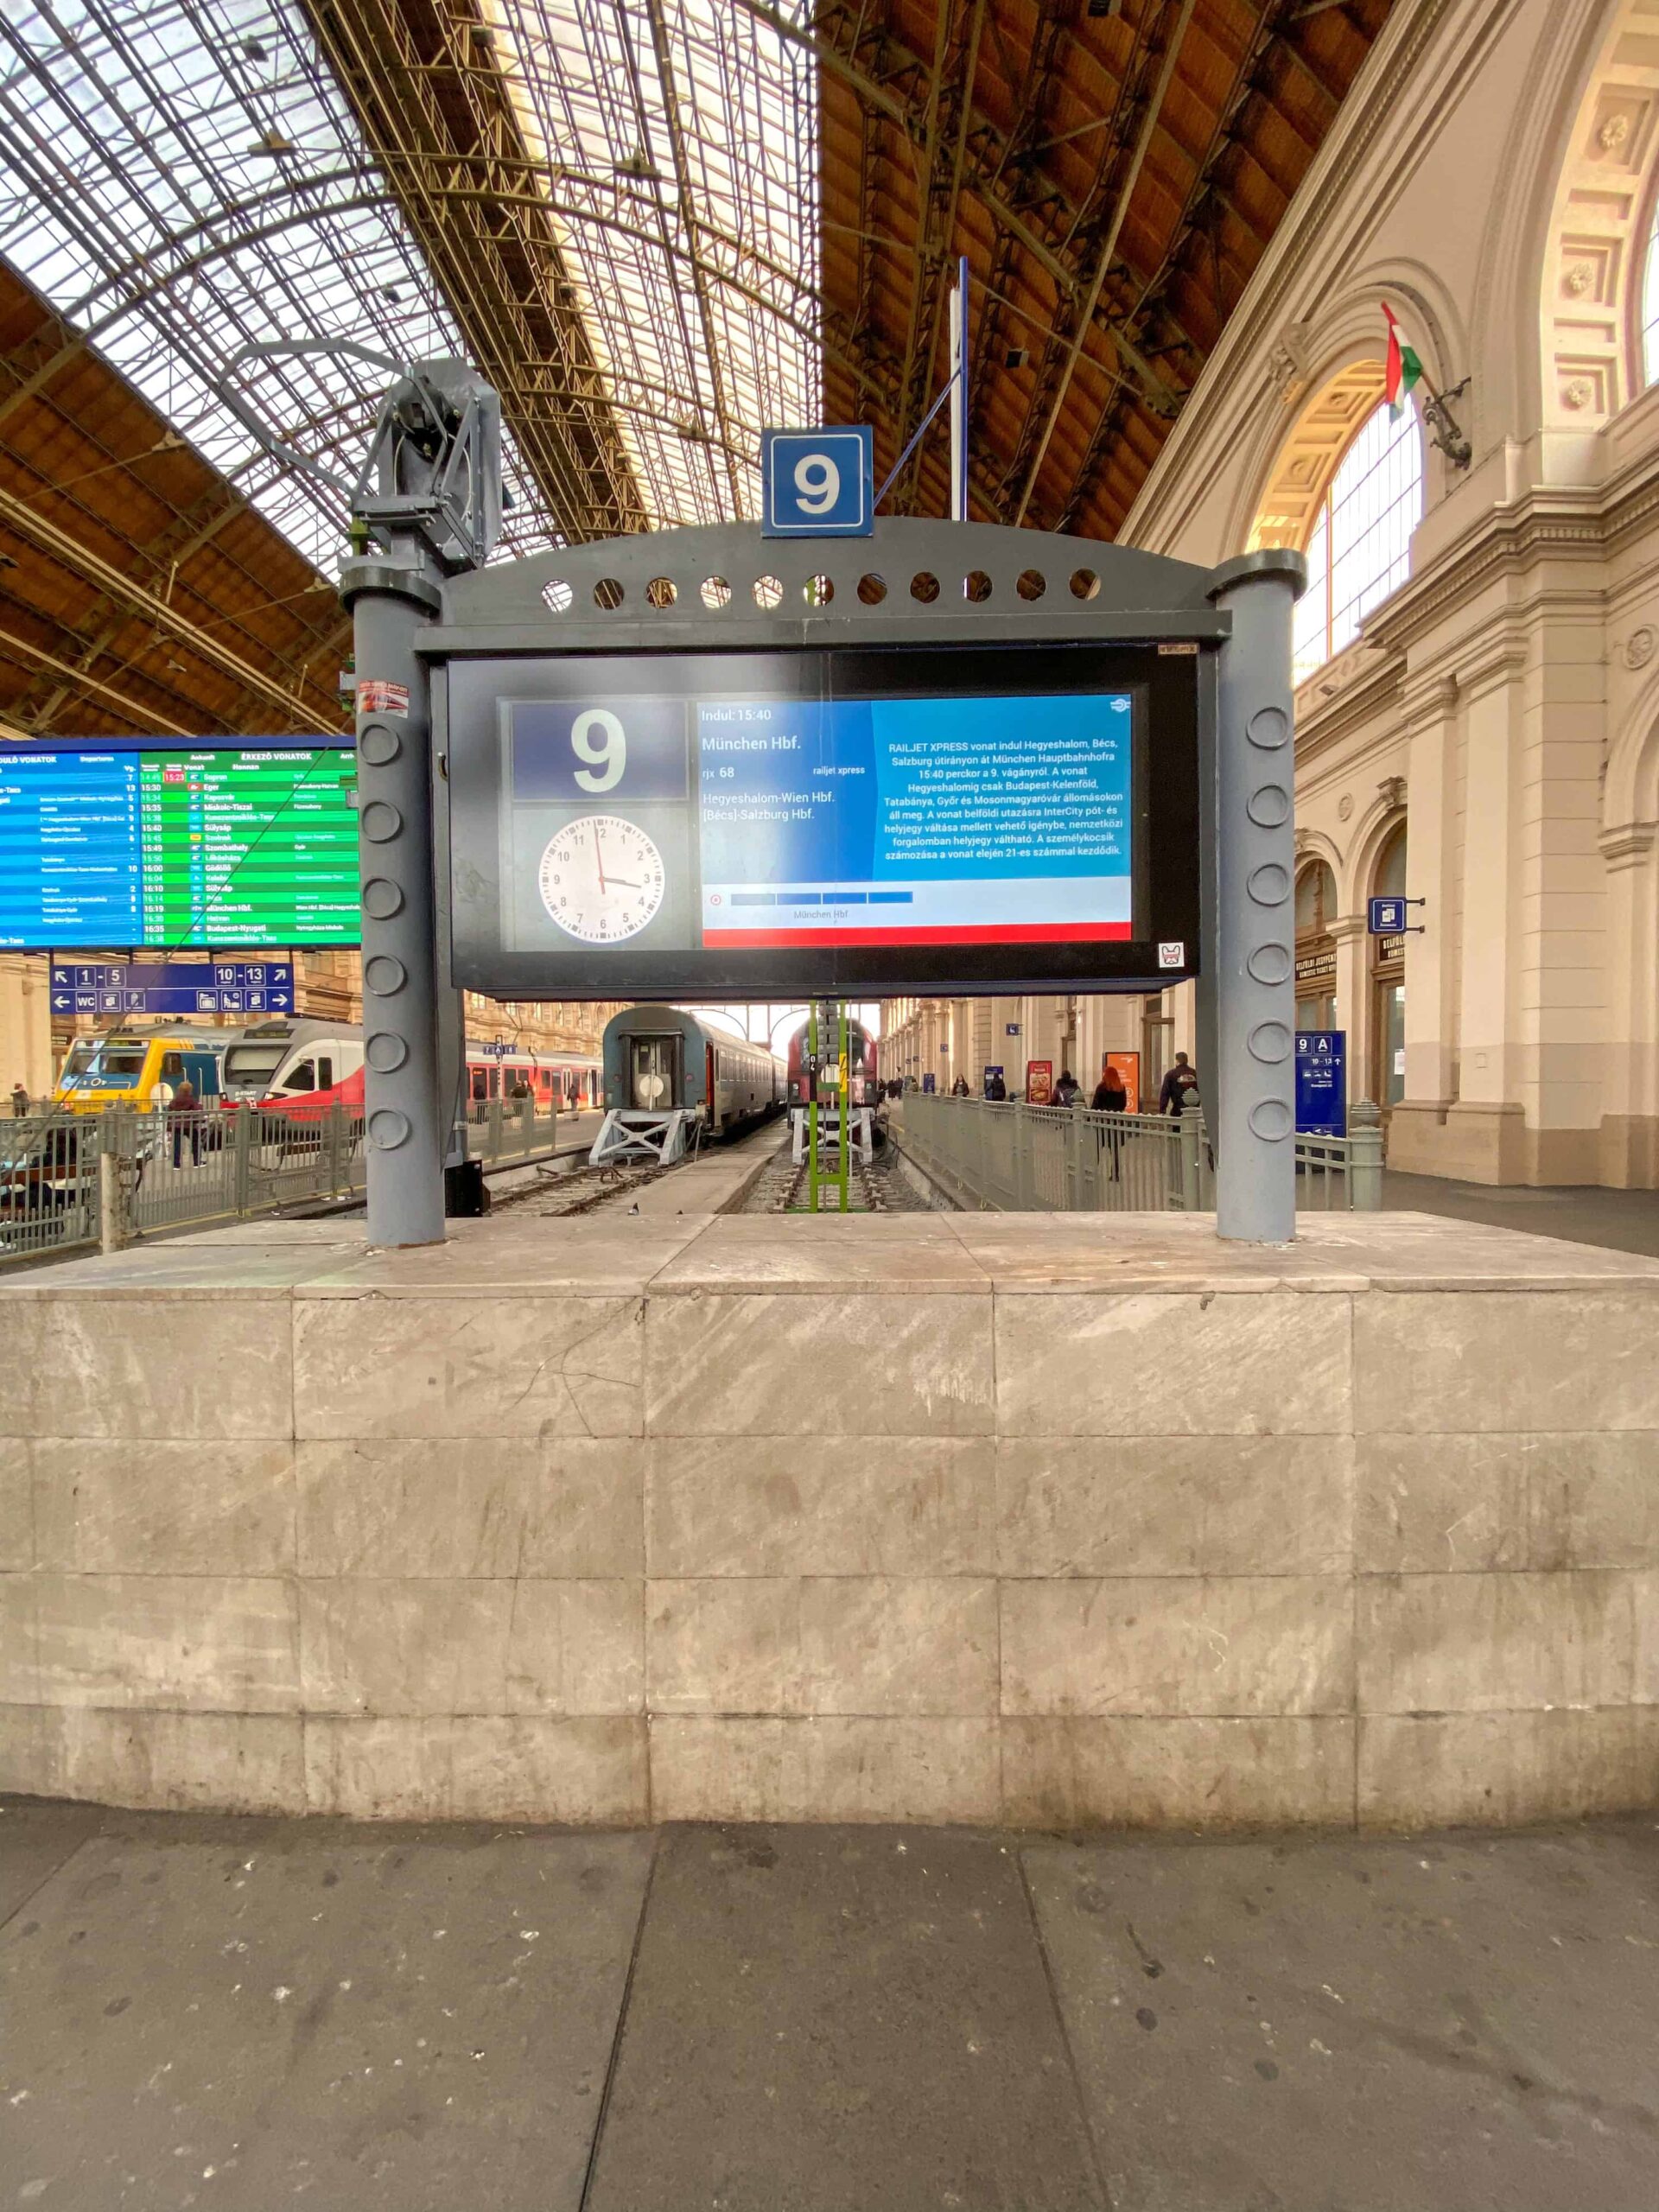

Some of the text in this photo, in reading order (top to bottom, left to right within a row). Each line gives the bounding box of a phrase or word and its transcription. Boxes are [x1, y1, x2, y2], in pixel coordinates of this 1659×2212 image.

[794, 454, 840, 514] 9
[702, 709, 772, 721] Indul: 15:40
[702, 735, 801, 751] München Hbf.
[888, 739, 1118, 753] RAILJET XPRESS vonat indul Hegyeshalom, Bécs,
[571, 709, 626, 792] 9
[892, 752, 1115, 767] Salzburg útirányon át München Hauptbahnhofra
[702, 766, 865, 781] rjx 68 railjet xpress
[919, 769, 944, 779] 15:40
[946, 769, 980, 780] perckor
[990, 768, 1000, 778] 9.
[1002, 767, 1049, 779] vágányról.
[1052, 767, 1059, 776] A
[1061, 766, 1088, 776] vonat
[908, 779, 1098, 794] Hegyeshalomig csak Budapest-Kelenföld,
[702, 791, 836, 806] Hegyeshalom-Wien Hbf.
[884, 793, 1123, 807] Tatabánya, Győr és Mosonmagyaróvár állomásokon
[792, 808, 815, 819] Hbf.
[889, 805, 1117, 821] áll meg. A vonat belföldi utazásra InterCity pót- és
[884, 818, 1122, 835] helyjegy váltása mellett vehető igénybe, nemzetközi
[574, 835, 584, 845] 11
[620, 835, 626, 844] 1
[893, 836, 950, 848] forgalomban
[953, 836, 991, 846] helyjegy
[994, 835, 1034, 844] váltható.
[1046, 832, 1115, 843] személykocsik
[557, 851, 569, 861] 10
[637, 851, 644, 861] 2
[885, 850, 938, 860] számozása
[948, 849, 974, 859] vonat
[976, 849, 1003, 860] elején
[1006, 849, 1031, 857] 21-es
[1033, 847, 1075, 856] számmal
[1077, 845, 1122, 856] kezdődik.
[554, 874, 560, 884] 9
[644, 874, 650, 883] 3
[561, 897, 567, 906] 8
[638, 897, 645, 906] 4
[576, 913, 583, 923] 7
[622, 912, 629, 922] 5
[794, 910, 848, 919] München Hbf
[600, 919, 607, 929] 6
[81, 969, 120, 982] 1 5
[218, 969, 232, 981] 10
[247, 968, 263, 980] 13
[78, 996, 94, 1007] WC
[1299, 1039, 1328, 1049] 9 A
